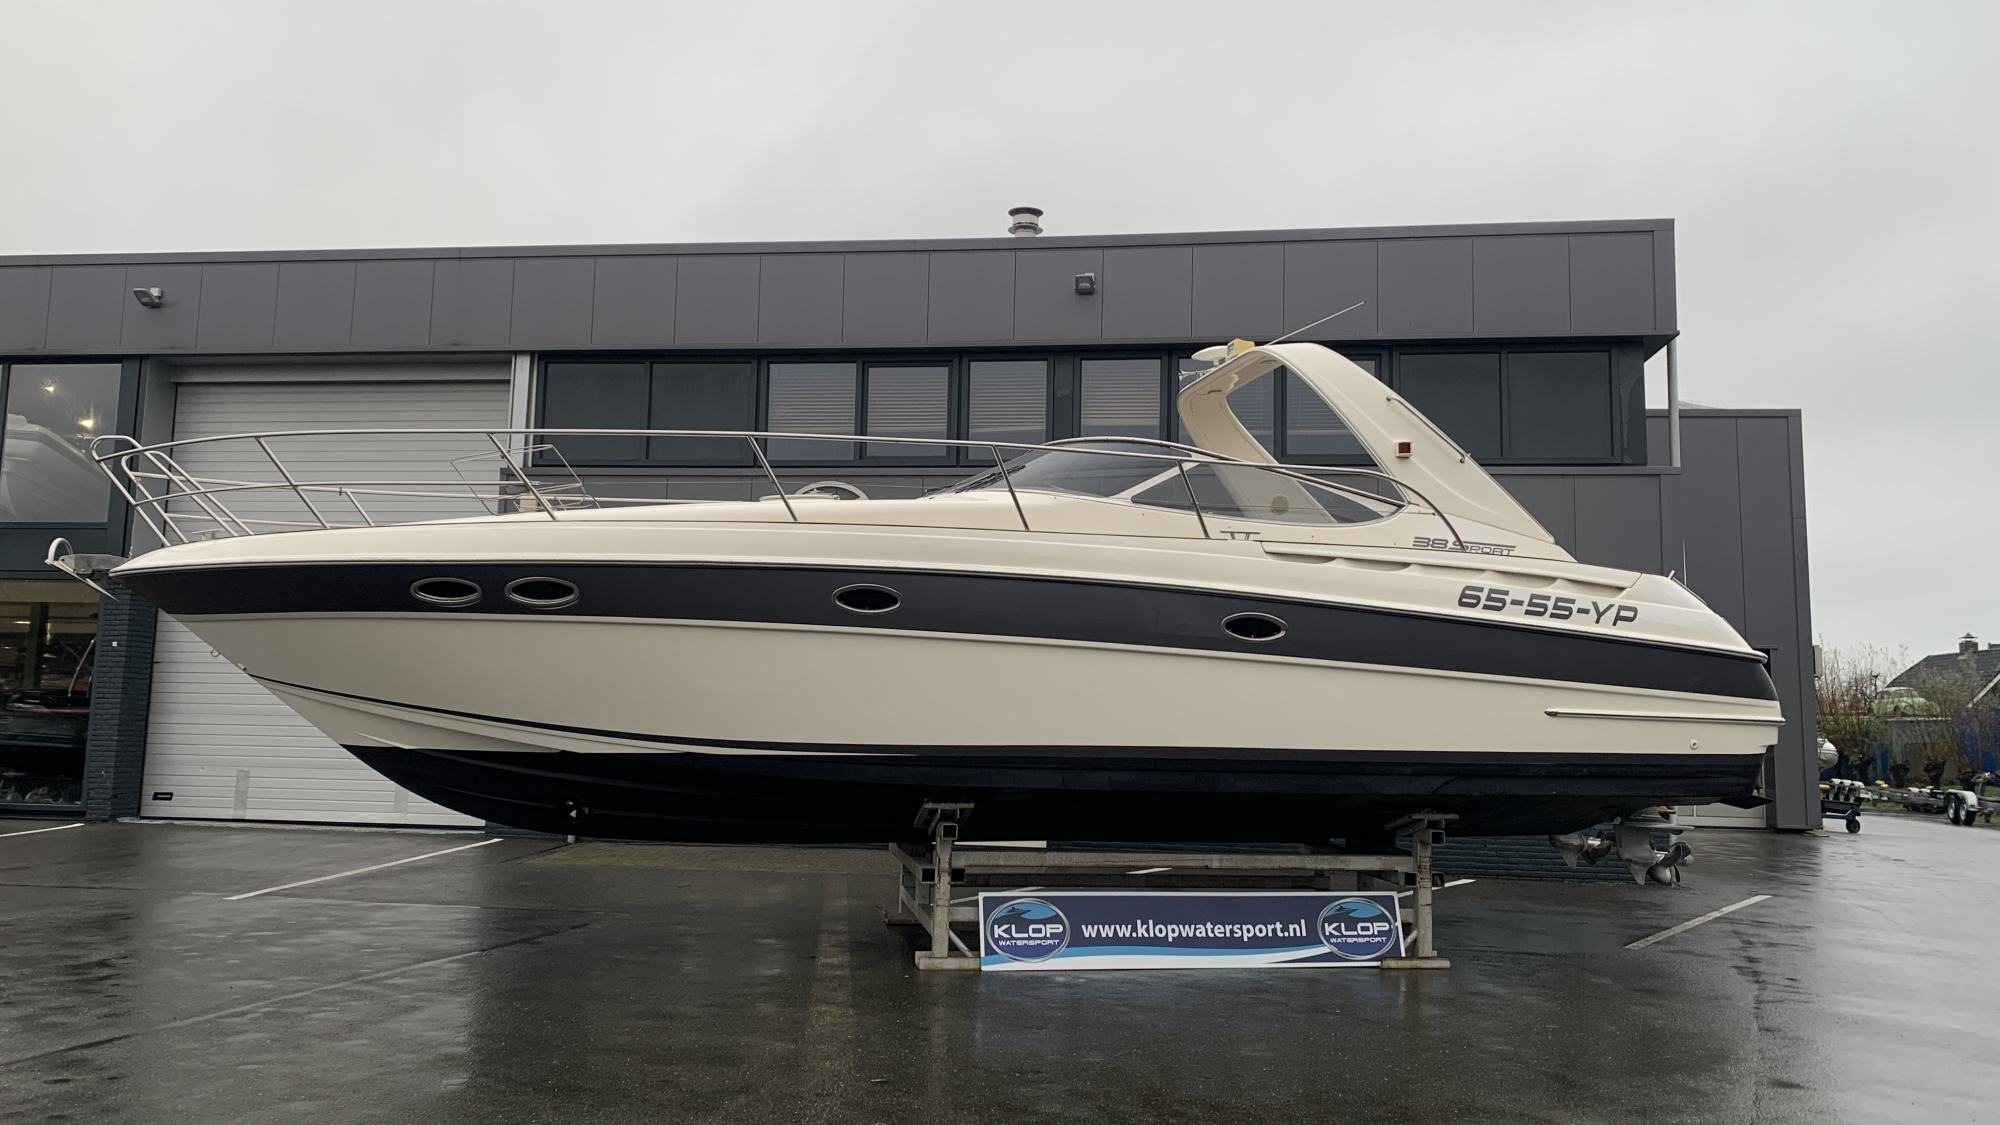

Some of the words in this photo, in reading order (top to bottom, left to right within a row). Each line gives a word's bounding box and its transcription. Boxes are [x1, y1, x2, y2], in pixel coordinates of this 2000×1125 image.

[1412, 536, 1449, 549] 38
[1457, 585, 1639, 627] 65-55-YP
[993, 924, 1064, 938] KLOP
[1081, 919, 1307, 942] www.klopwatersport.nl
[1324, 922, 1390, 936] KLOP
